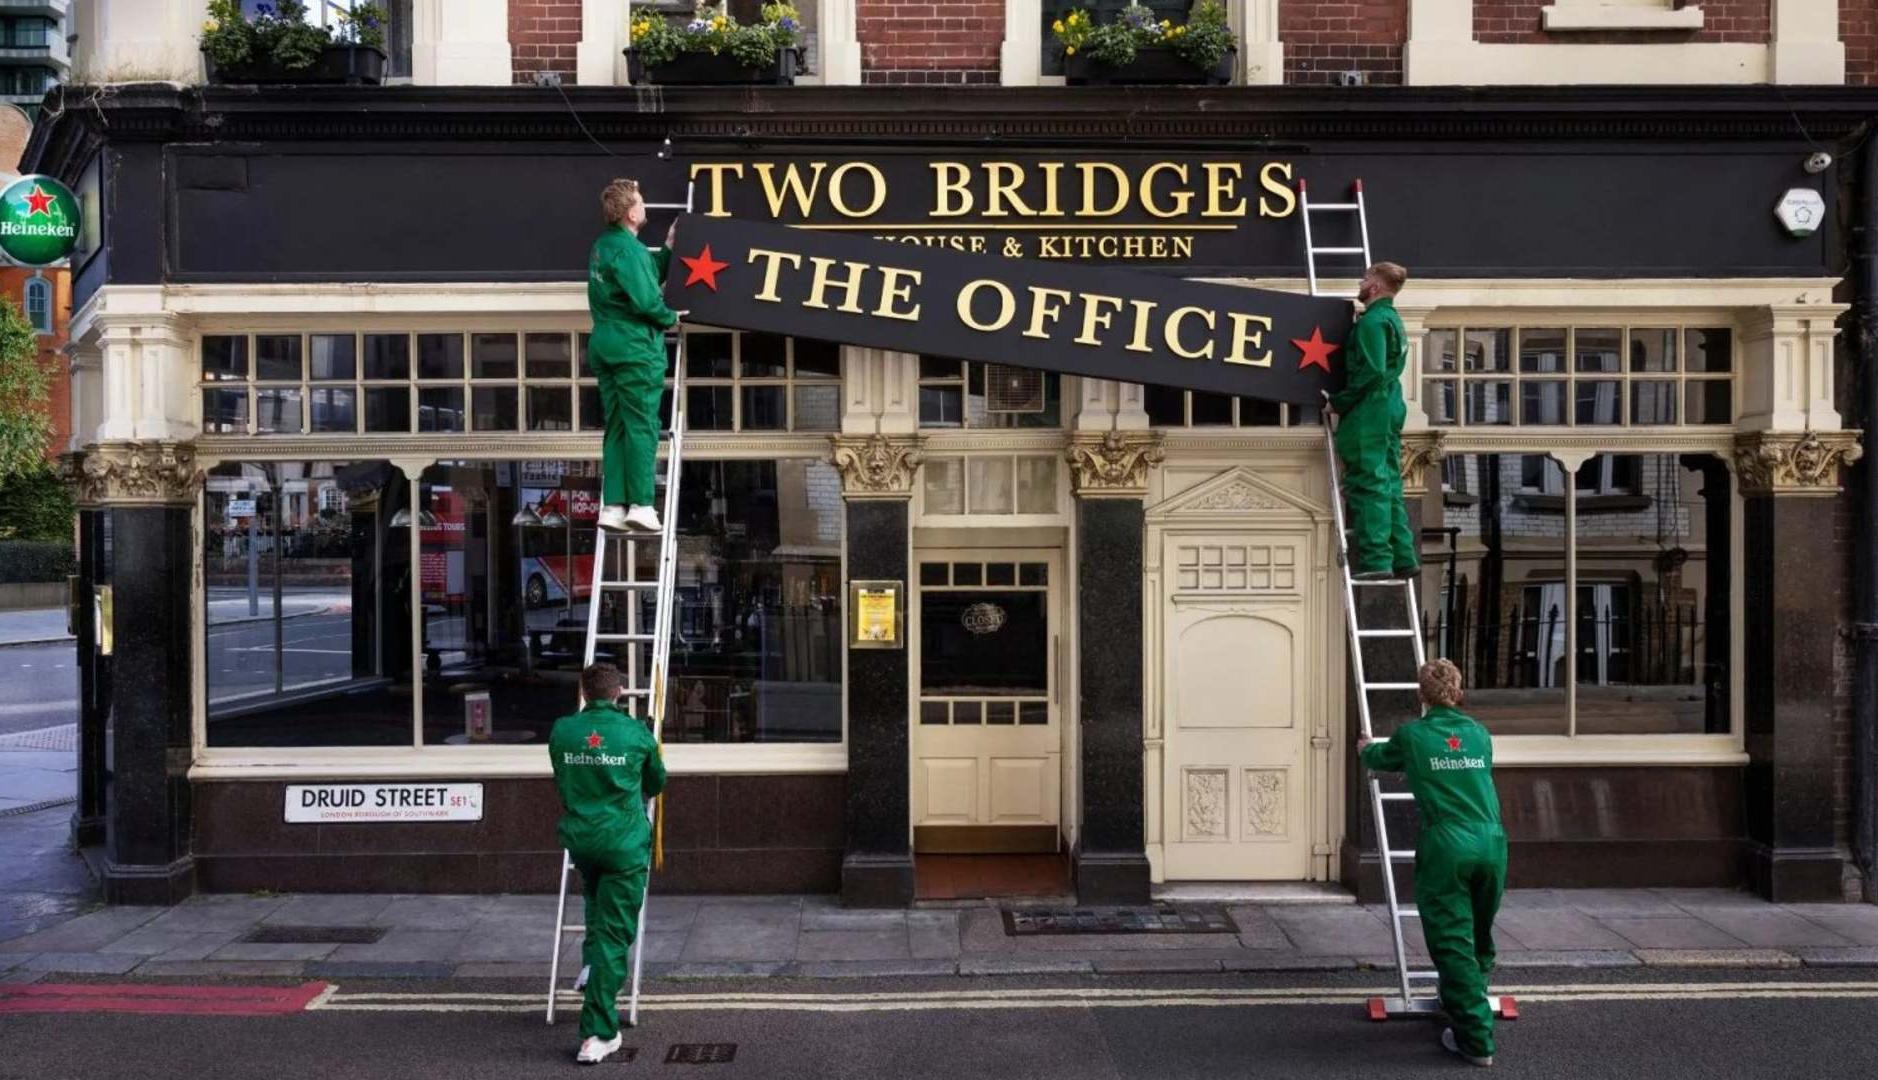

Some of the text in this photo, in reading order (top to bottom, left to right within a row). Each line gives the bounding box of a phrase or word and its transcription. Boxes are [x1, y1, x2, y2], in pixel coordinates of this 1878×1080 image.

[691, 162, 1296, 218] TWO BRIDGES
[0, 221, 74, 237] Heineken
[1003, 236, 1023, 258] &
[1039, 236, 1194, 258] KITCHEN
[748, 248, 1273, 368] THE OFFICE
[563, 752, 626, 766] Heineken
[1430, 756, 1485, 770] Heineken
[302, 789, 366, 808] DRUID
[375, 788, 448, 807] STREET
